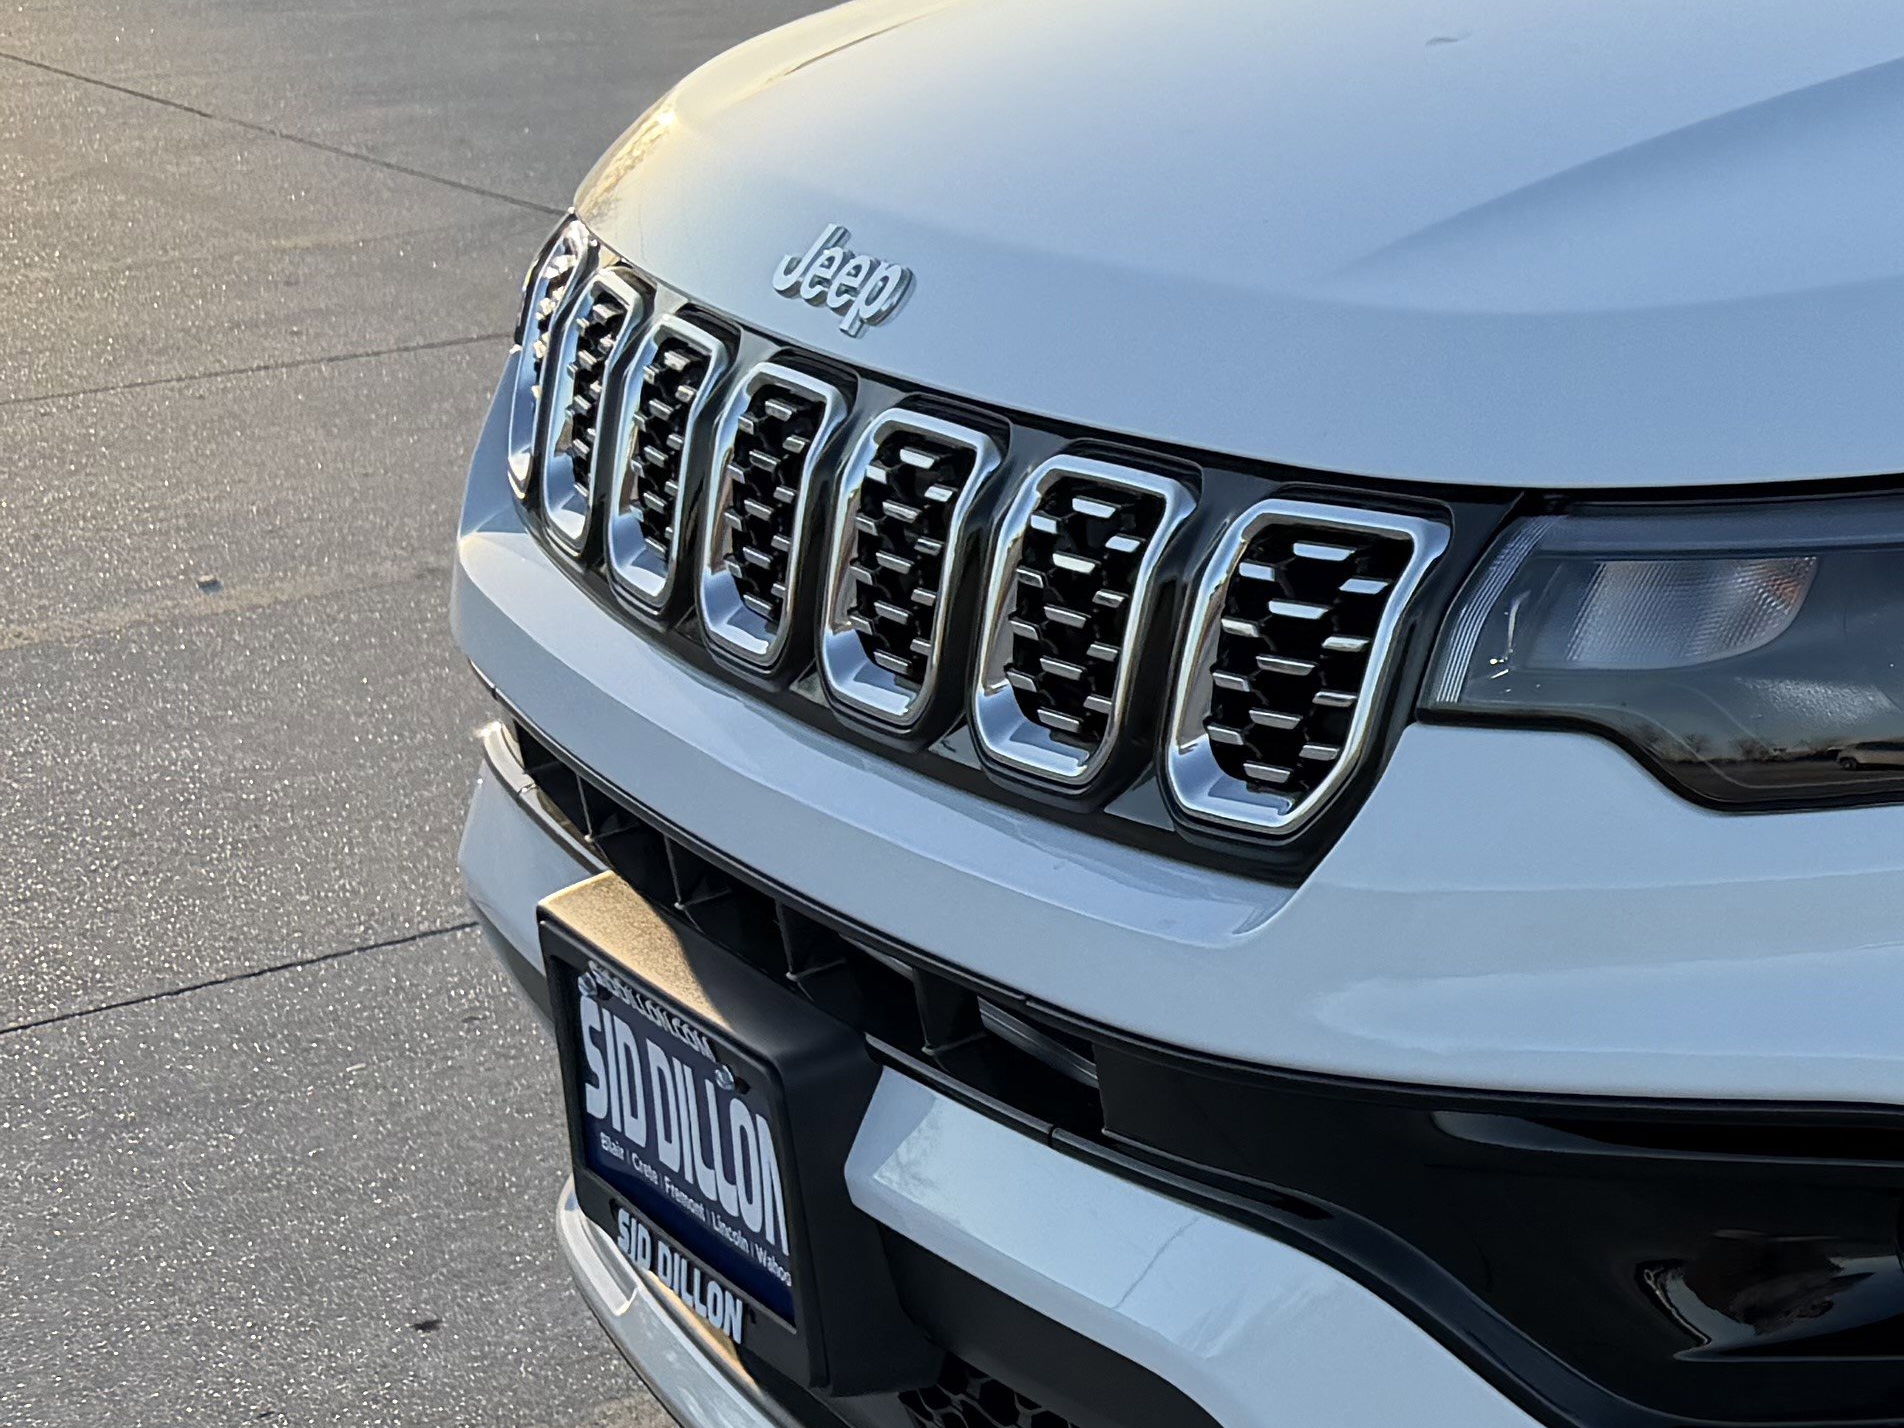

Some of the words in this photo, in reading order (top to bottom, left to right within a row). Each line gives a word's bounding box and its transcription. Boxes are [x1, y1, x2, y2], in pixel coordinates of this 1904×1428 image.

[772, 222, 916, 338] Jeep
[579, 993, 648, 1149] SID
[646, 1036, 791, 1258] DILLON
[616, 1205, 654, 1273] SID
[656, 1237, 744, 1346] DILLON
